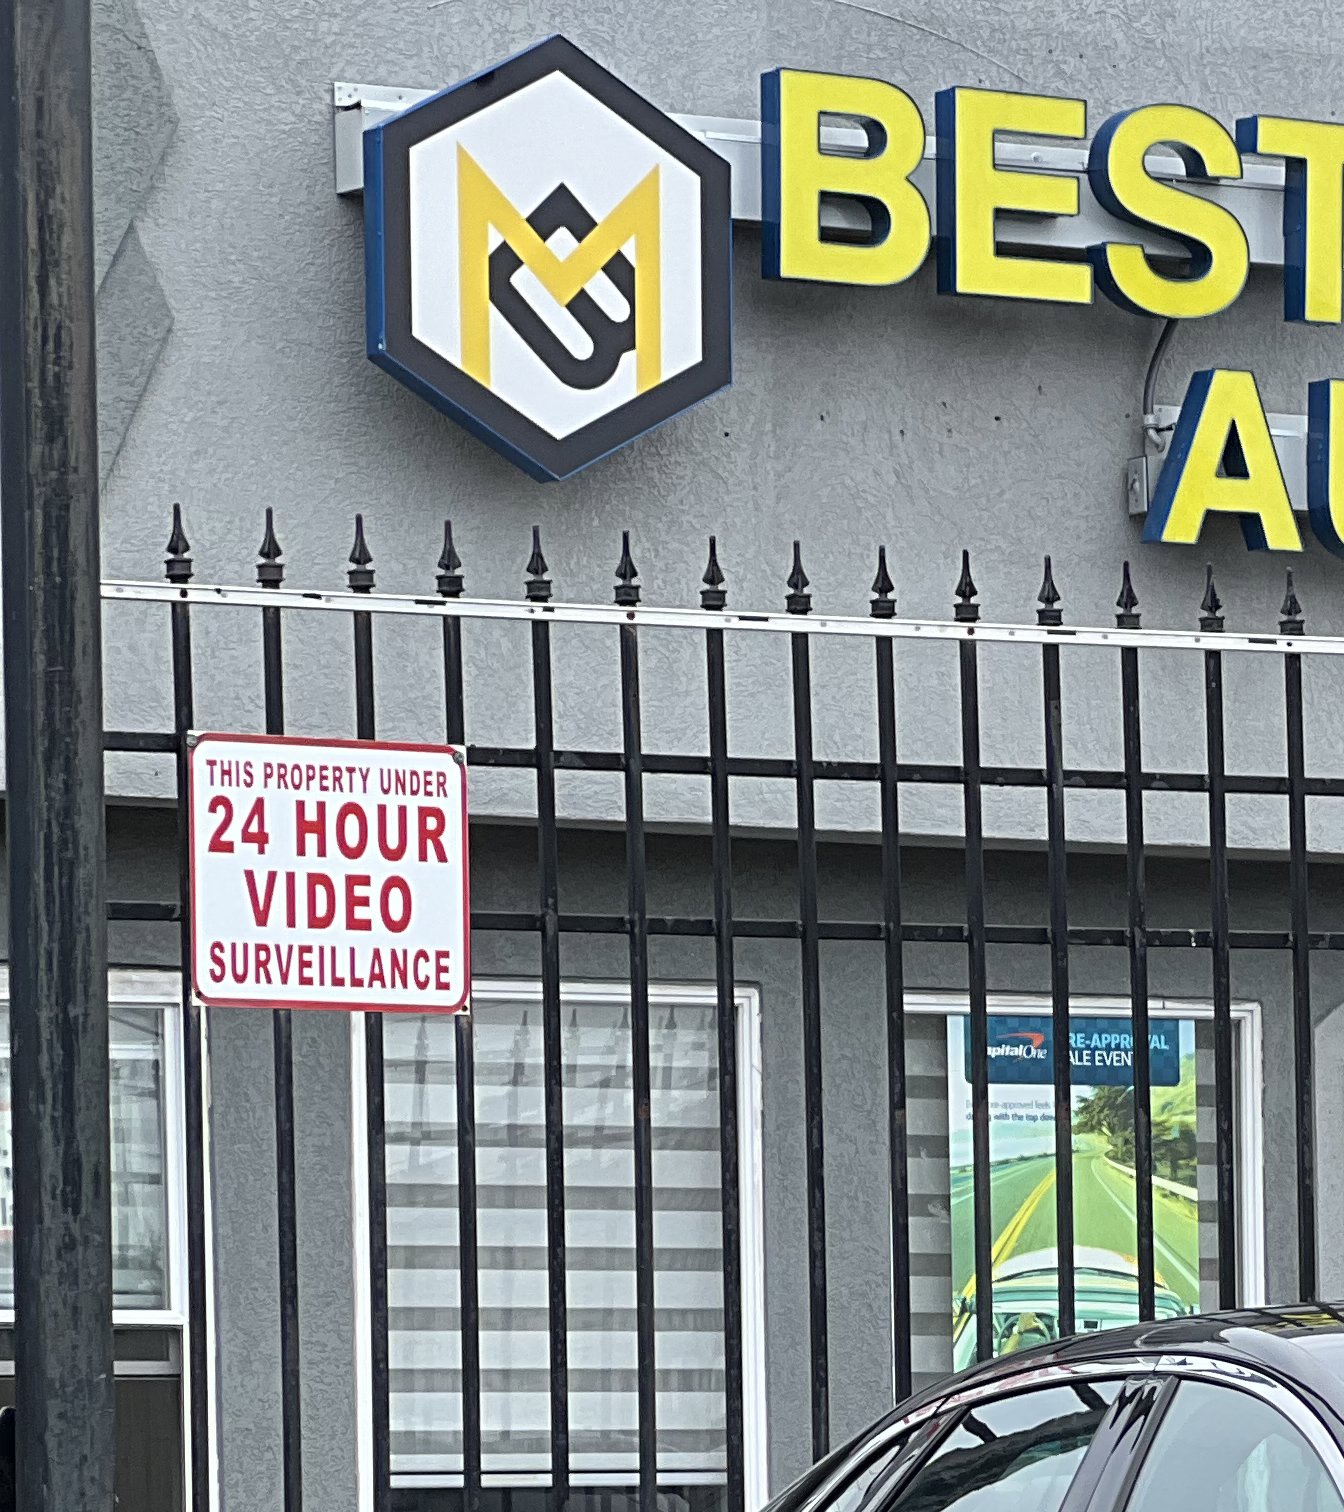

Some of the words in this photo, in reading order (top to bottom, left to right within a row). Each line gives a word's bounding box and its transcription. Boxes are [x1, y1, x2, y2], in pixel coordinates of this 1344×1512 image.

[206, 759, 254, 788] THIS
[263, 762, 370, 794] PROPERTY
[379, 767, 448, 798] UNDER
[208, 795, 269, 855] 24
[295, 800, 448, 863] HOUR
[243, 869, 412, 933] VIDEO
[209, 940, 450, 991] SURVEILLANCE
[1069, 1032, 1169, 1050] RE-APPRAL
[1069, 1050, 1091, 1066] ALE
